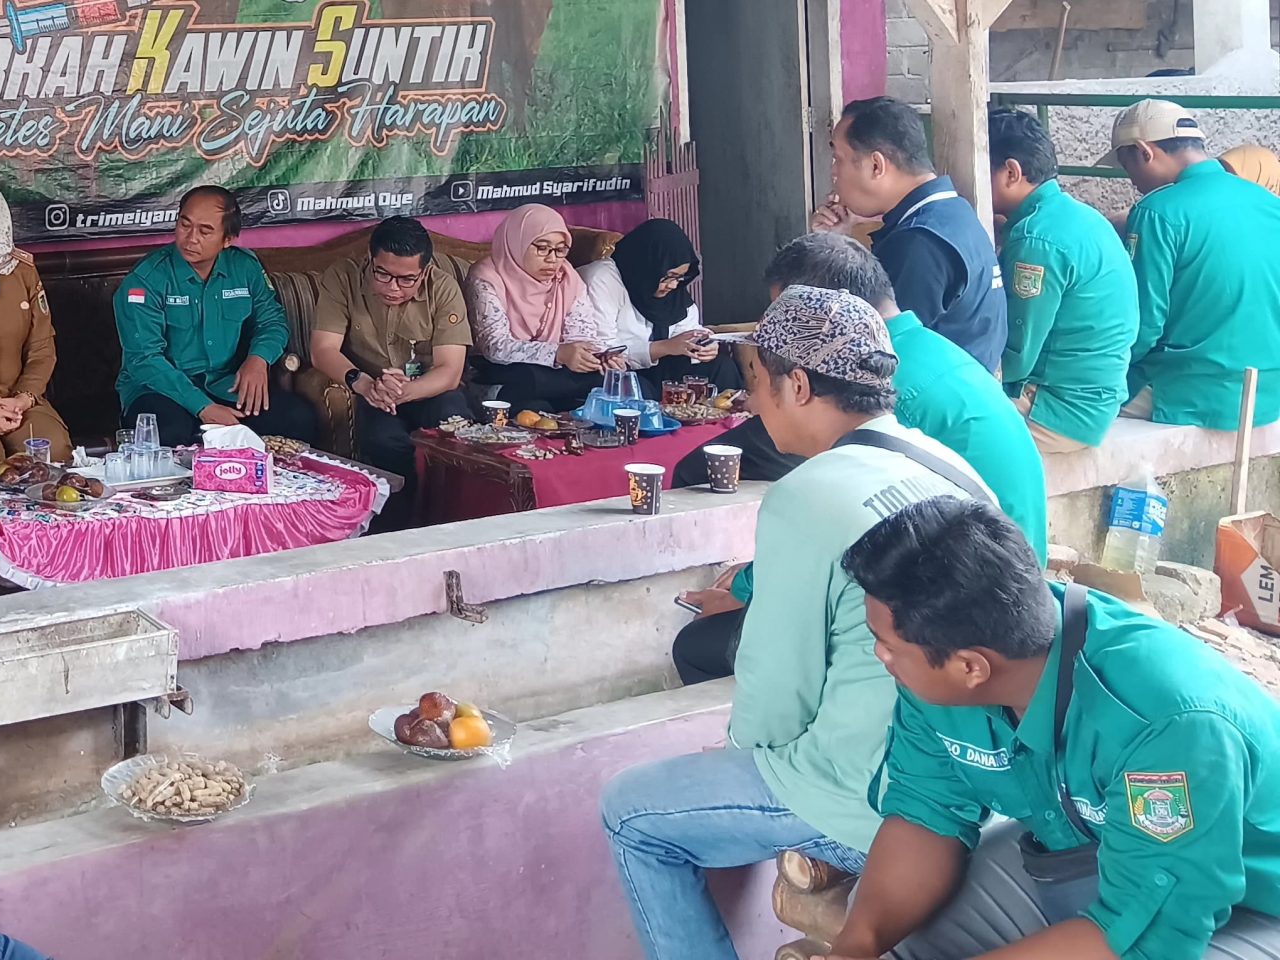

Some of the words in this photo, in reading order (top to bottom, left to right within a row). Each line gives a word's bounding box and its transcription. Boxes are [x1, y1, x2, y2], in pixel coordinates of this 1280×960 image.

[126, 9, 304, 95] KAWIN
[307, 5, 487, 87] SUNTIK
[65, 93, 193, 151] Mani
[200, 87, 334, 157] Sejuta
[337, 81, 500, 146] Harapan
[476, 182, 541, 200] Mahmud
[542, 177, 631, 198] Syarifudin
[297, 195, 374, 212] Mahmud
[378, 192, 413, 210] Oye
[76, 209, 179, 228] trimeiyan
[219, 465, 242, 476] jolly
[1257, 564, 1275, 604] LEM
